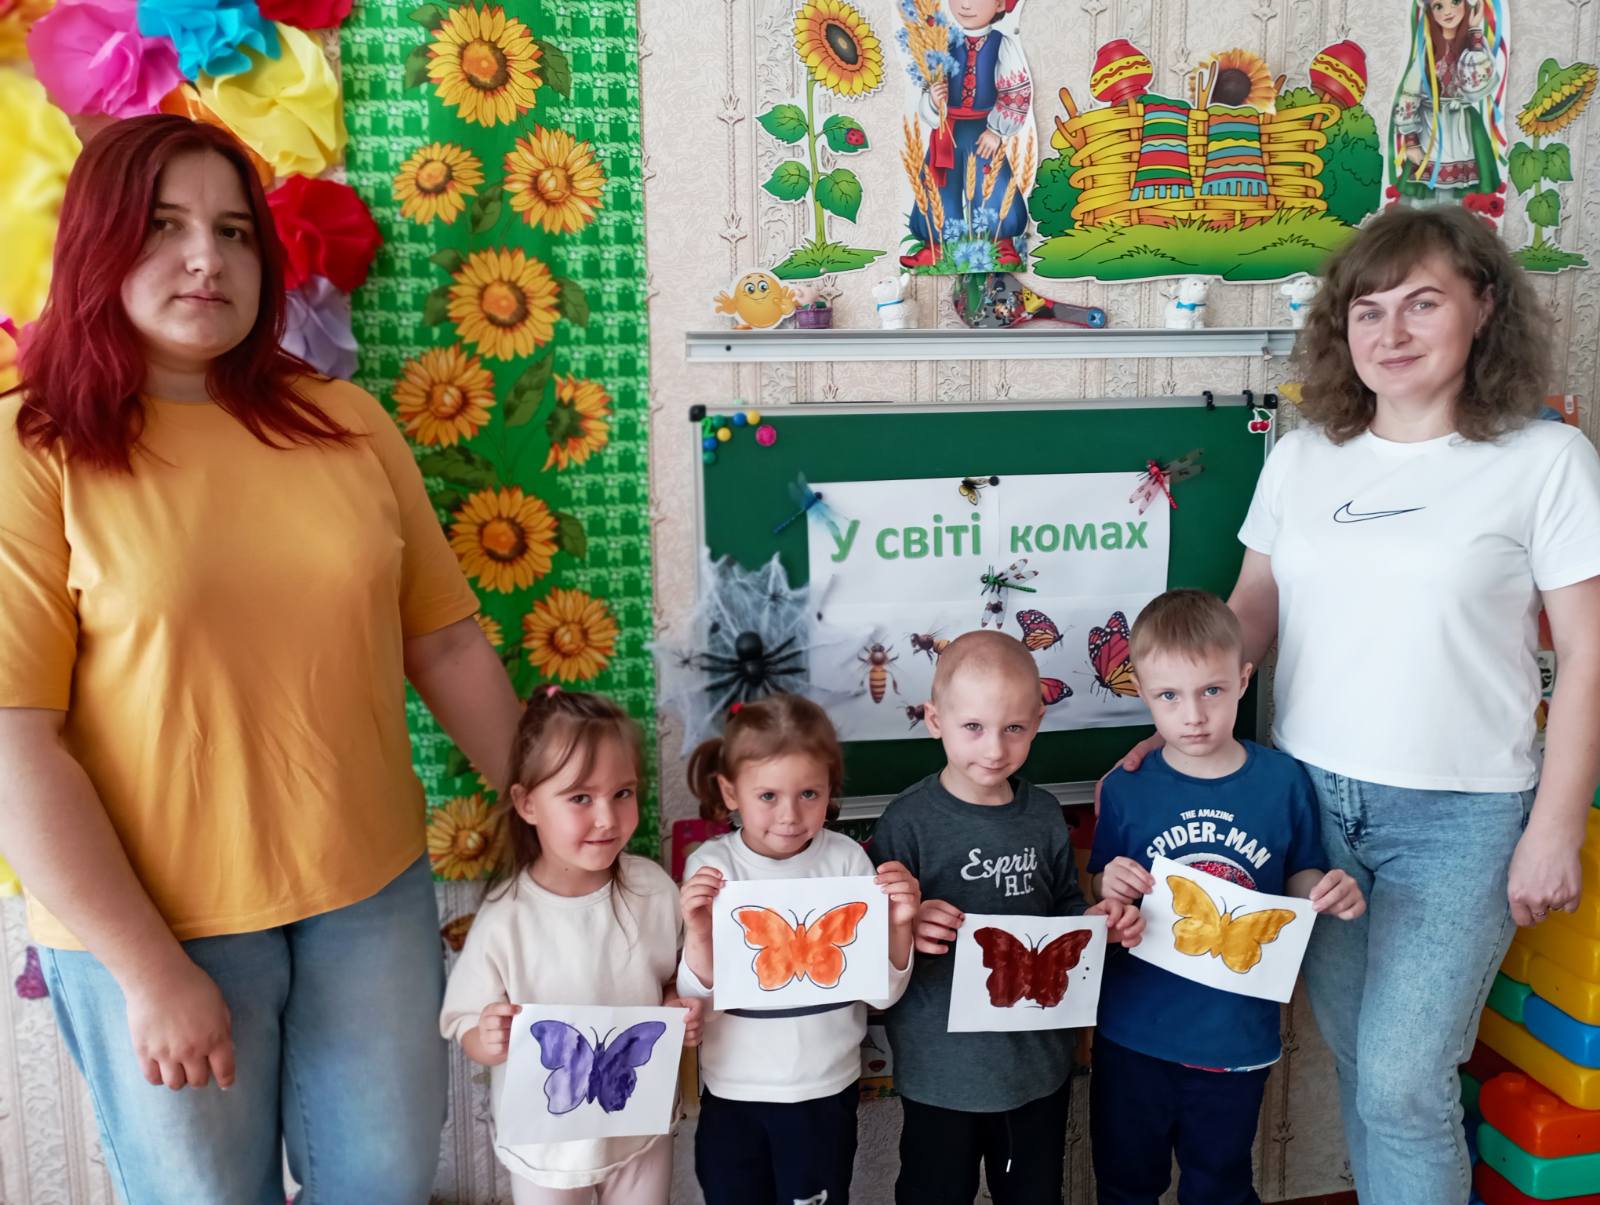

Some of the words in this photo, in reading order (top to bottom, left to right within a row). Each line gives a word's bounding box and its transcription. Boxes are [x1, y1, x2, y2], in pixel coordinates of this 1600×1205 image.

[876, 512, 982, 559] світі
[1010, 521, 1148, 553] комах
[1180, 810, 1196, 820] THE
[1198, 809, 1234, 822] AMAZING
[1146, 821, 1271, 869] SPIDER-MAN
[960, 847, 1037, 888] Esprit
